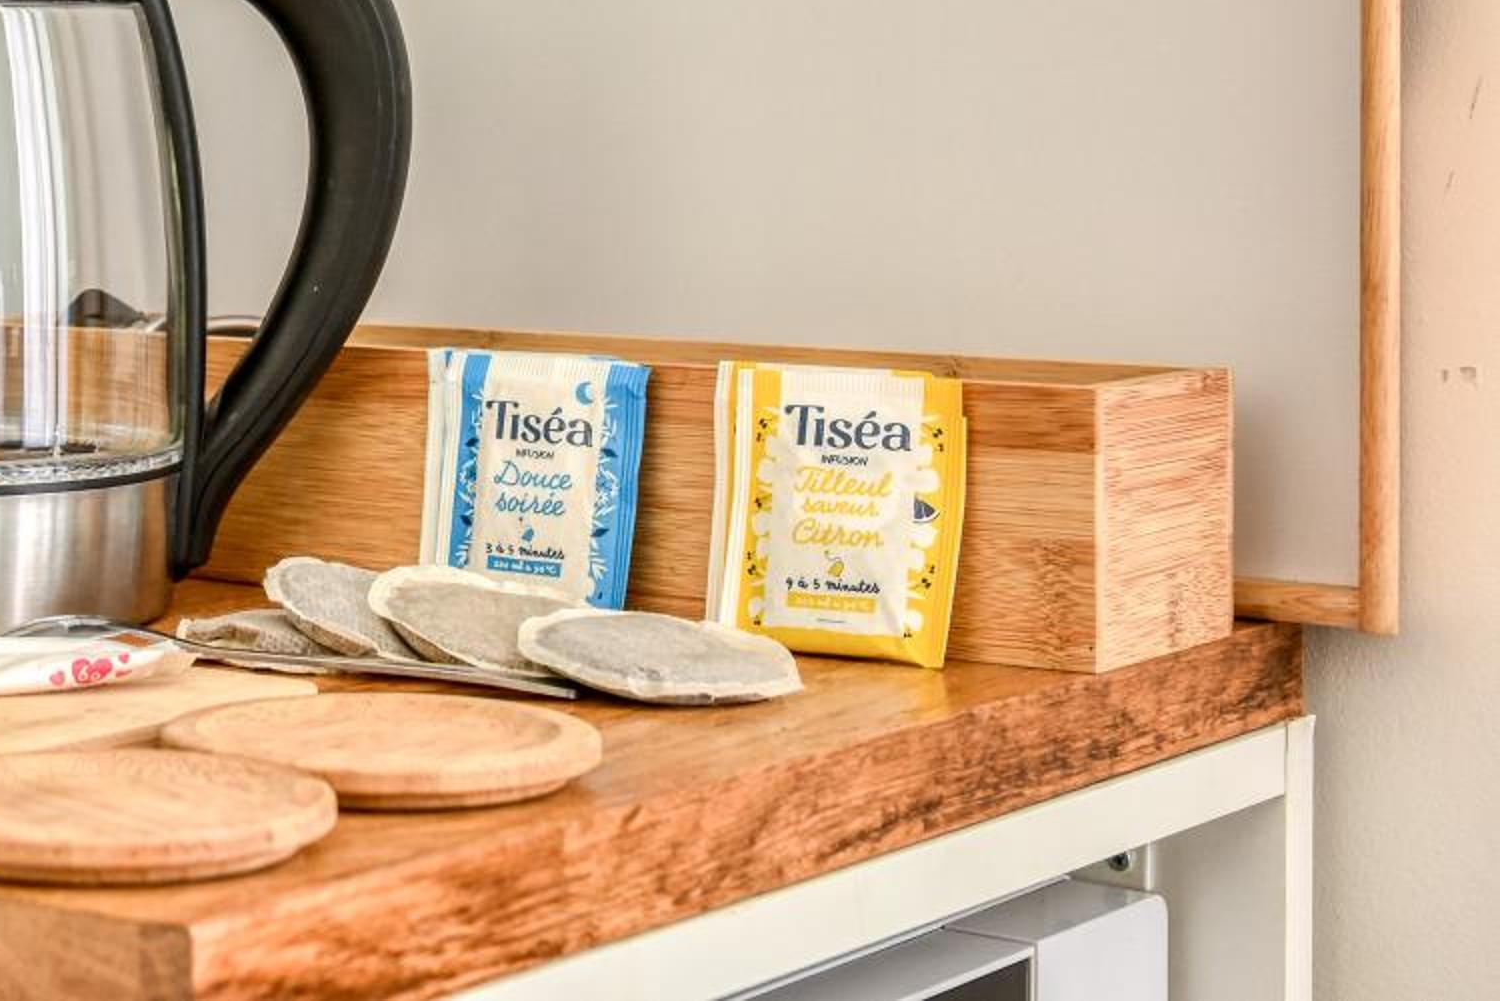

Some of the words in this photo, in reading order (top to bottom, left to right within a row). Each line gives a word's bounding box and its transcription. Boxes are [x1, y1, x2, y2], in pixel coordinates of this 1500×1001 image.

[485, 400, 593, 448] Tiséa
[784, 404, 912, 452] Tiséa
[494, 459, 573, 490] Douce
[821, 453, 869, 467] INFUSION
[794, 465, 894, 497] Tilleul
[495, 489, 566, 516] soirée
[791, 517, 884, 548] Citron
[518, 545, 566, 560] minutes
[797, 576, 809, 589] à
[813, 577, 821, 590] 5
[825, 579, 881, 595] minutes
